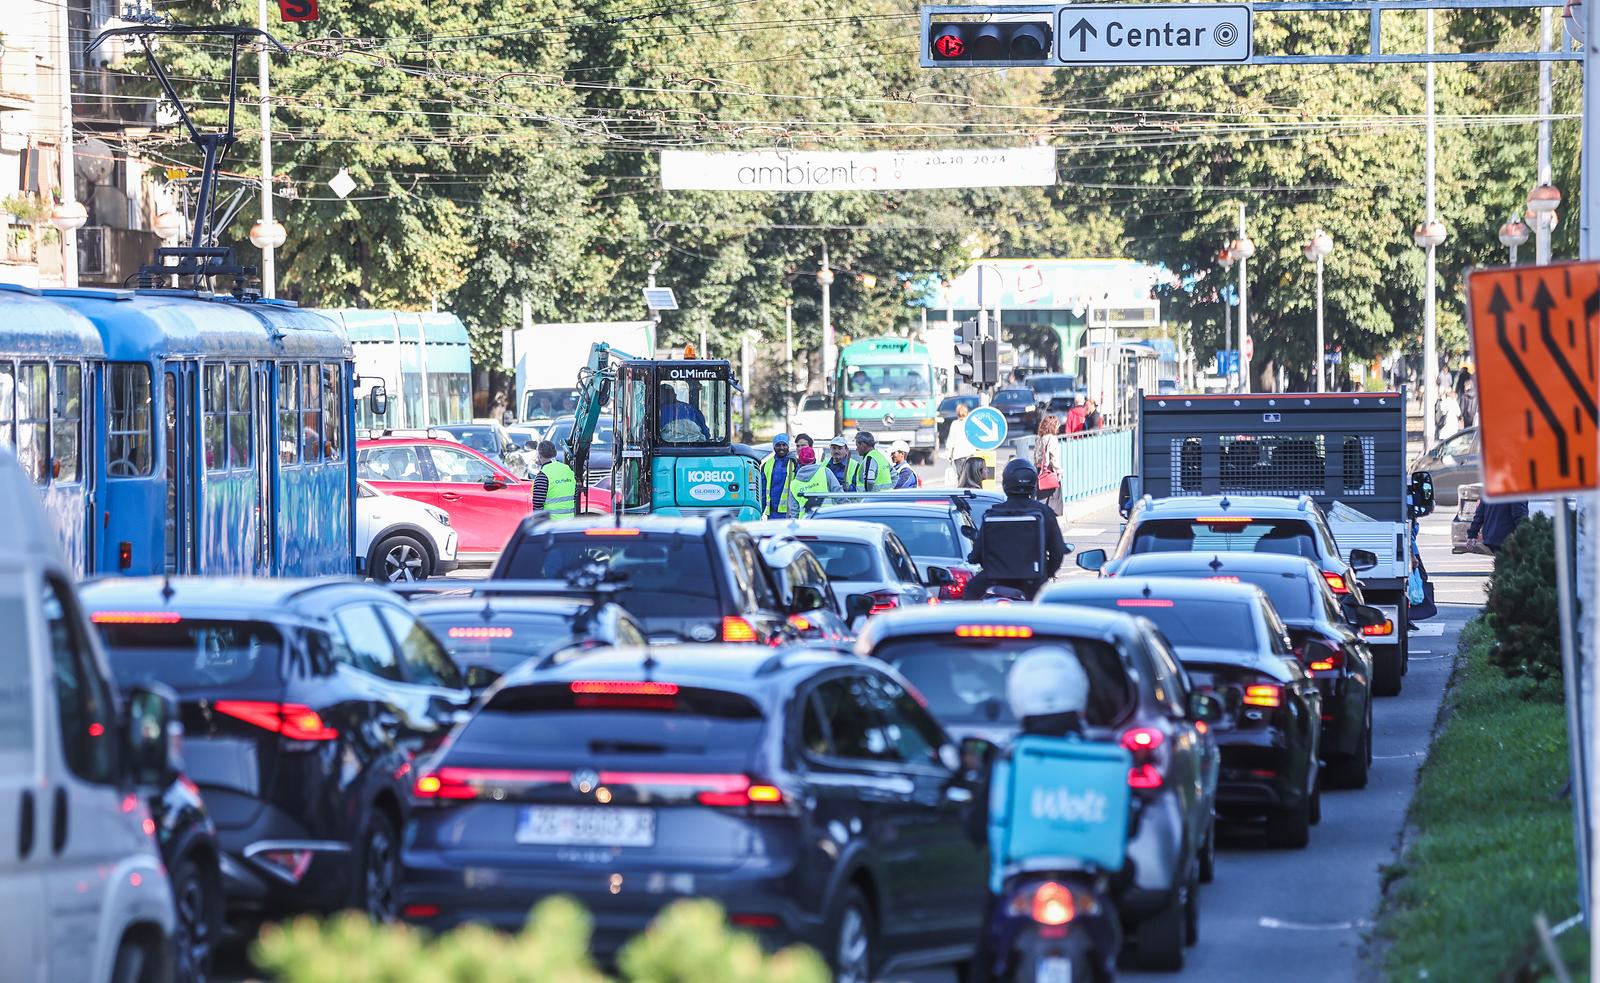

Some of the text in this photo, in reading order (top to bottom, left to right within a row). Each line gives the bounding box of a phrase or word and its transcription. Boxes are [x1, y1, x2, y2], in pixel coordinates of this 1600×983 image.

[1106, 21, 1206, 47] Centar
[737, 155, 877, 185] ambienta
[670, 369, 717, 379] OLMinfra
[687, 470, 735, 483] KOBELCO
